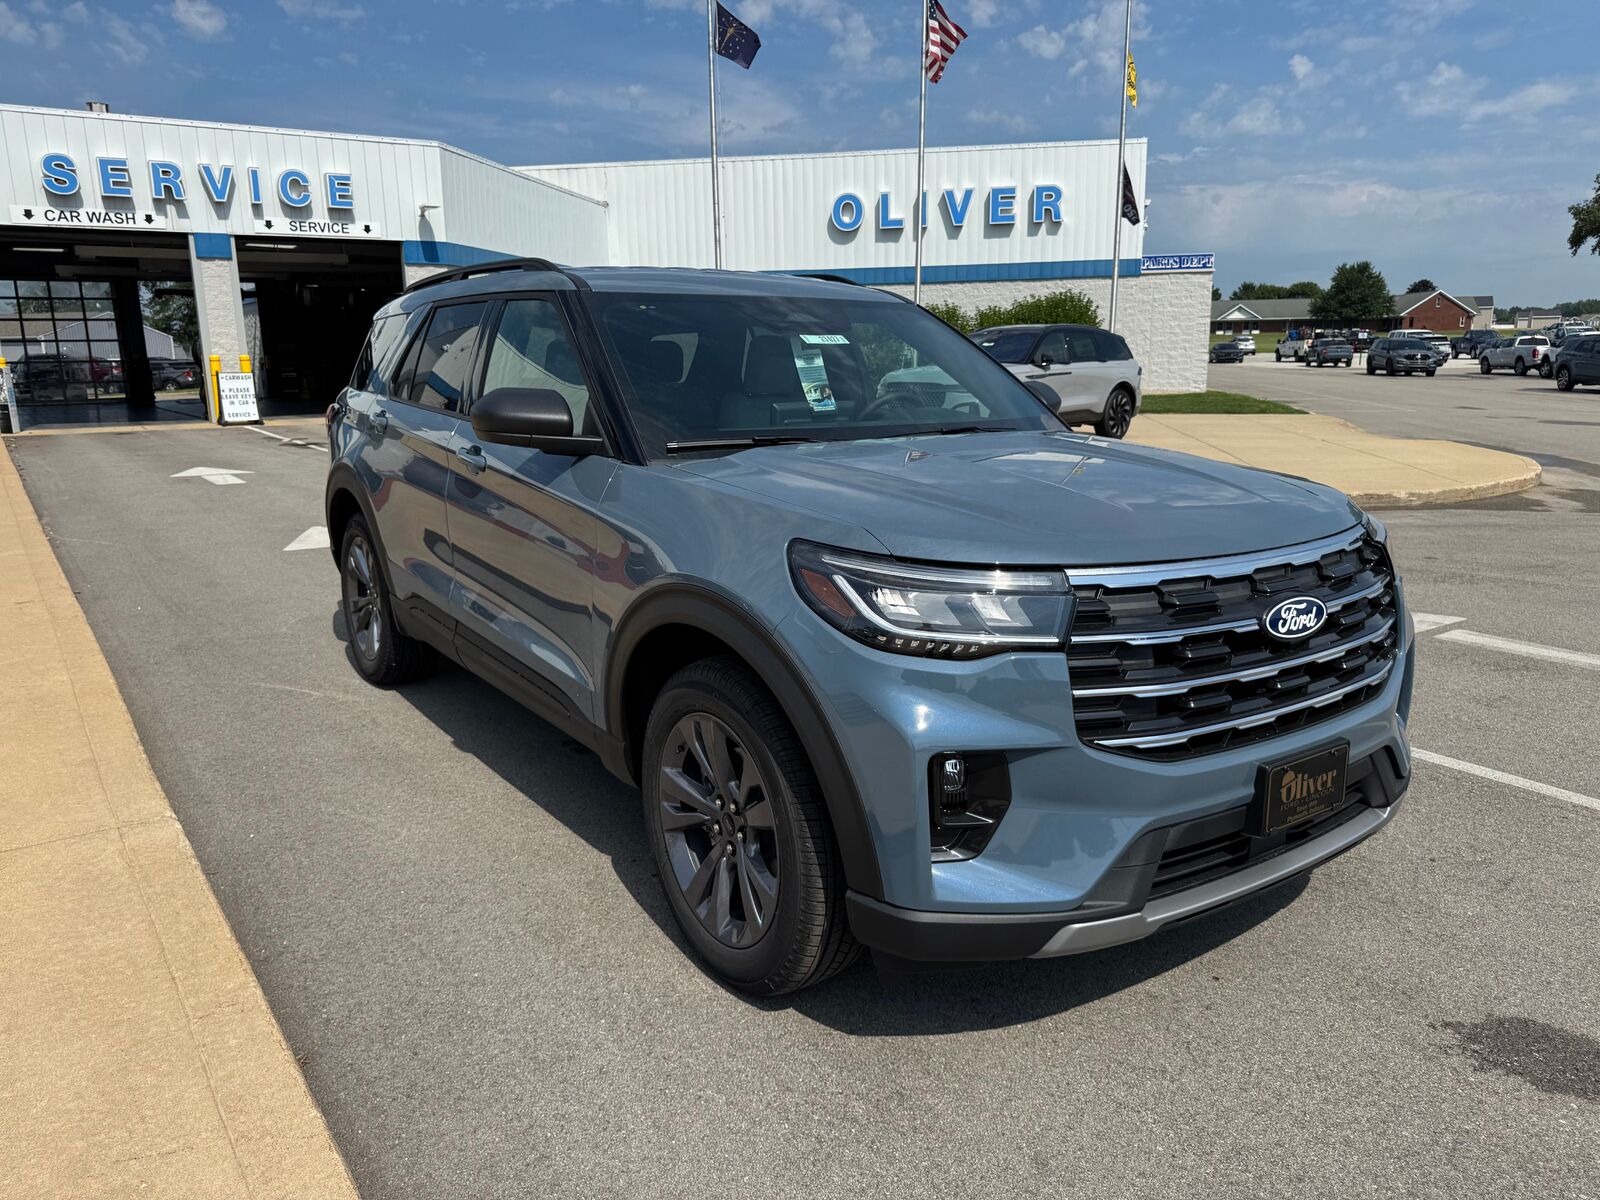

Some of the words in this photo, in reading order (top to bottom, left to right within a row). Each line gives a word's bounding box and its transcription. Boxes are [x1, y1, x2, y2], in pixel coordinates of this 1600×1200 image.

[41, 153, 355, 209] SERVICE
[44, 209, 82, 223] CAR
[86, 210, 137, 225] WASH
[831, 184, 1065, 232] OLIVER
[289, 220, 350, 234] SERVICE
[1141, 256, 1180, 269] PARTS
[1278, 602, 1317, 634] Ford
[1280, 769, 1337, 803] Oliver
